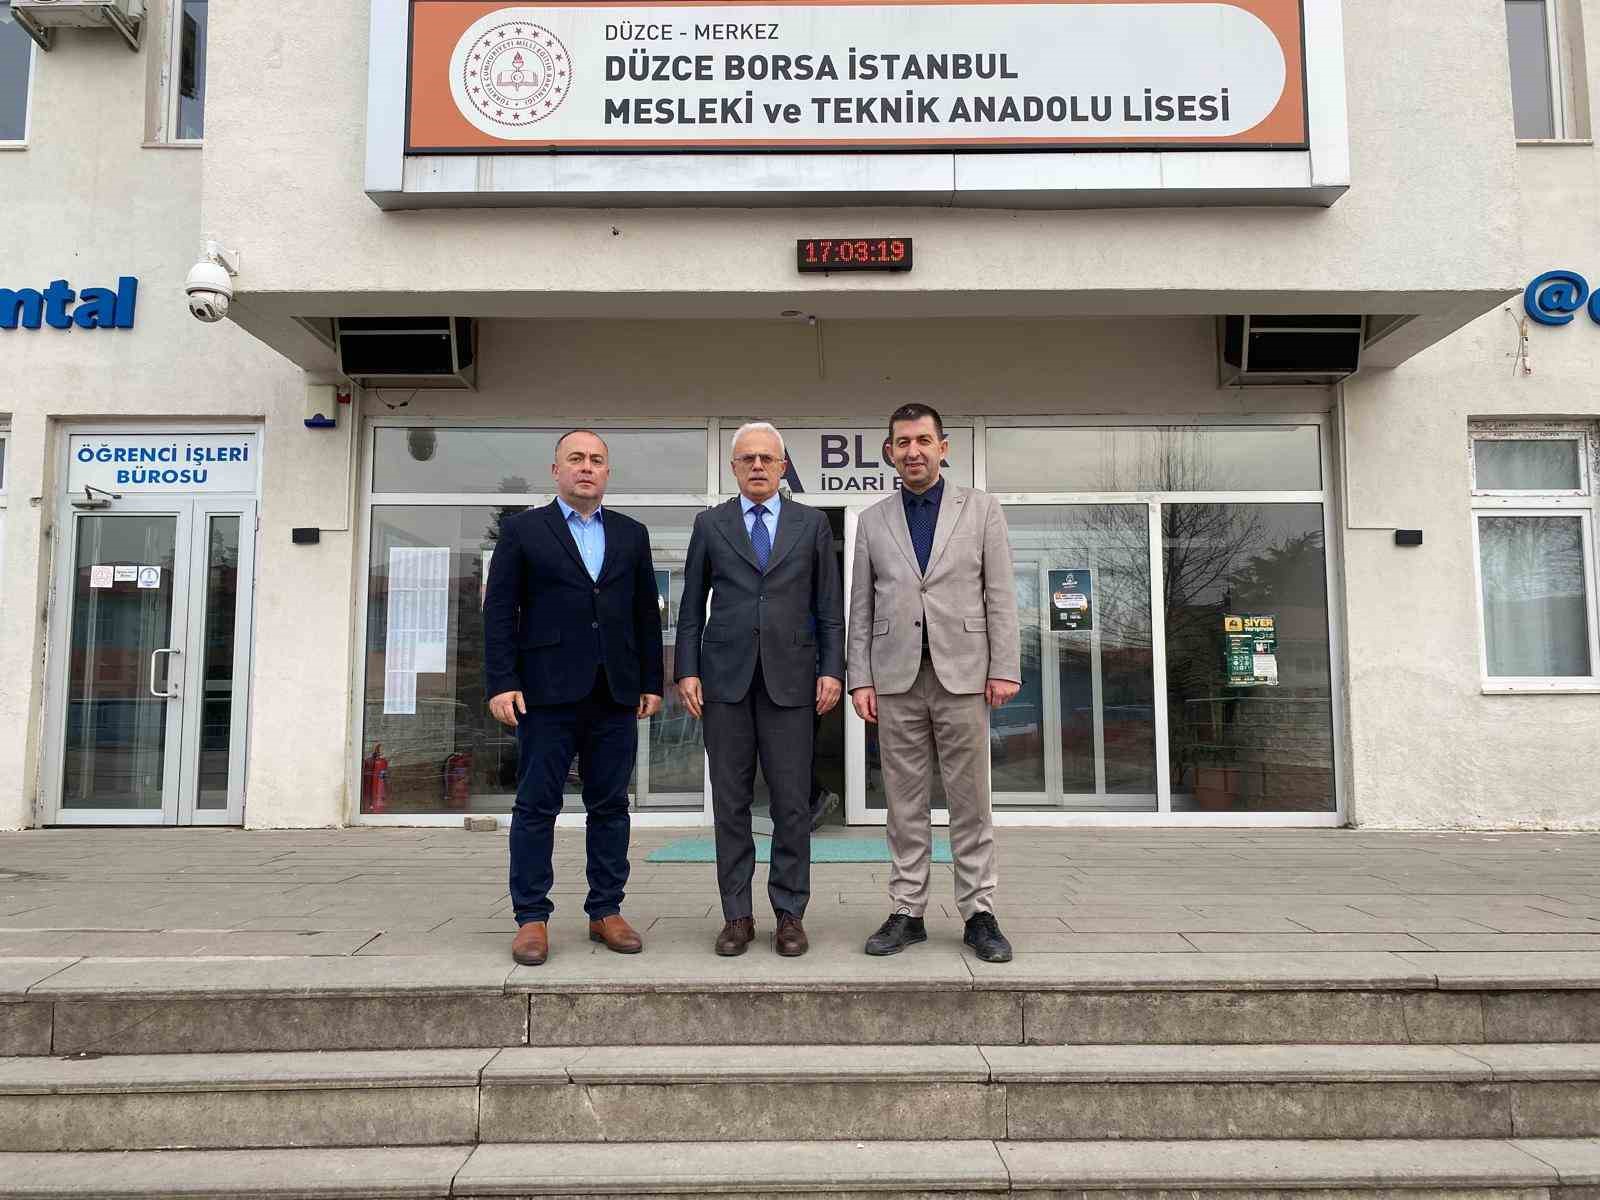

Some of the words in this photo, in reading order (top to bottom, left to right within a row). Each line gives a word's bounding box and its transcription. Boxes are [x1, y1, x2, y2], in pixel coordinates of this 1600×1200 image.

[605, 20, 673, 41] DÜZCE
[694, 23, 779, 40] MERKEZ
[605, 48, 714, 81] DÜZCE
[724, 54, 839, 81] BORSA
[848, 47, 1018, 80] İSTANBUL
[604, 90, 753, 124] MESLEKİ
[763, 103, 801, 124] ve
[811, 89, 940, 124] TEKNİK
[948, 95, 1112, 123] ANADOLU
[1123, 87, 1230, 122] LİSESİ
[77, 443, 177, 463] ÖĞRENCİ
[185, 442, 249, 466] İŞLERİ
[116, 465, 208, 484] BÜROSU
[820, 472, 884, 491] İDARİ
